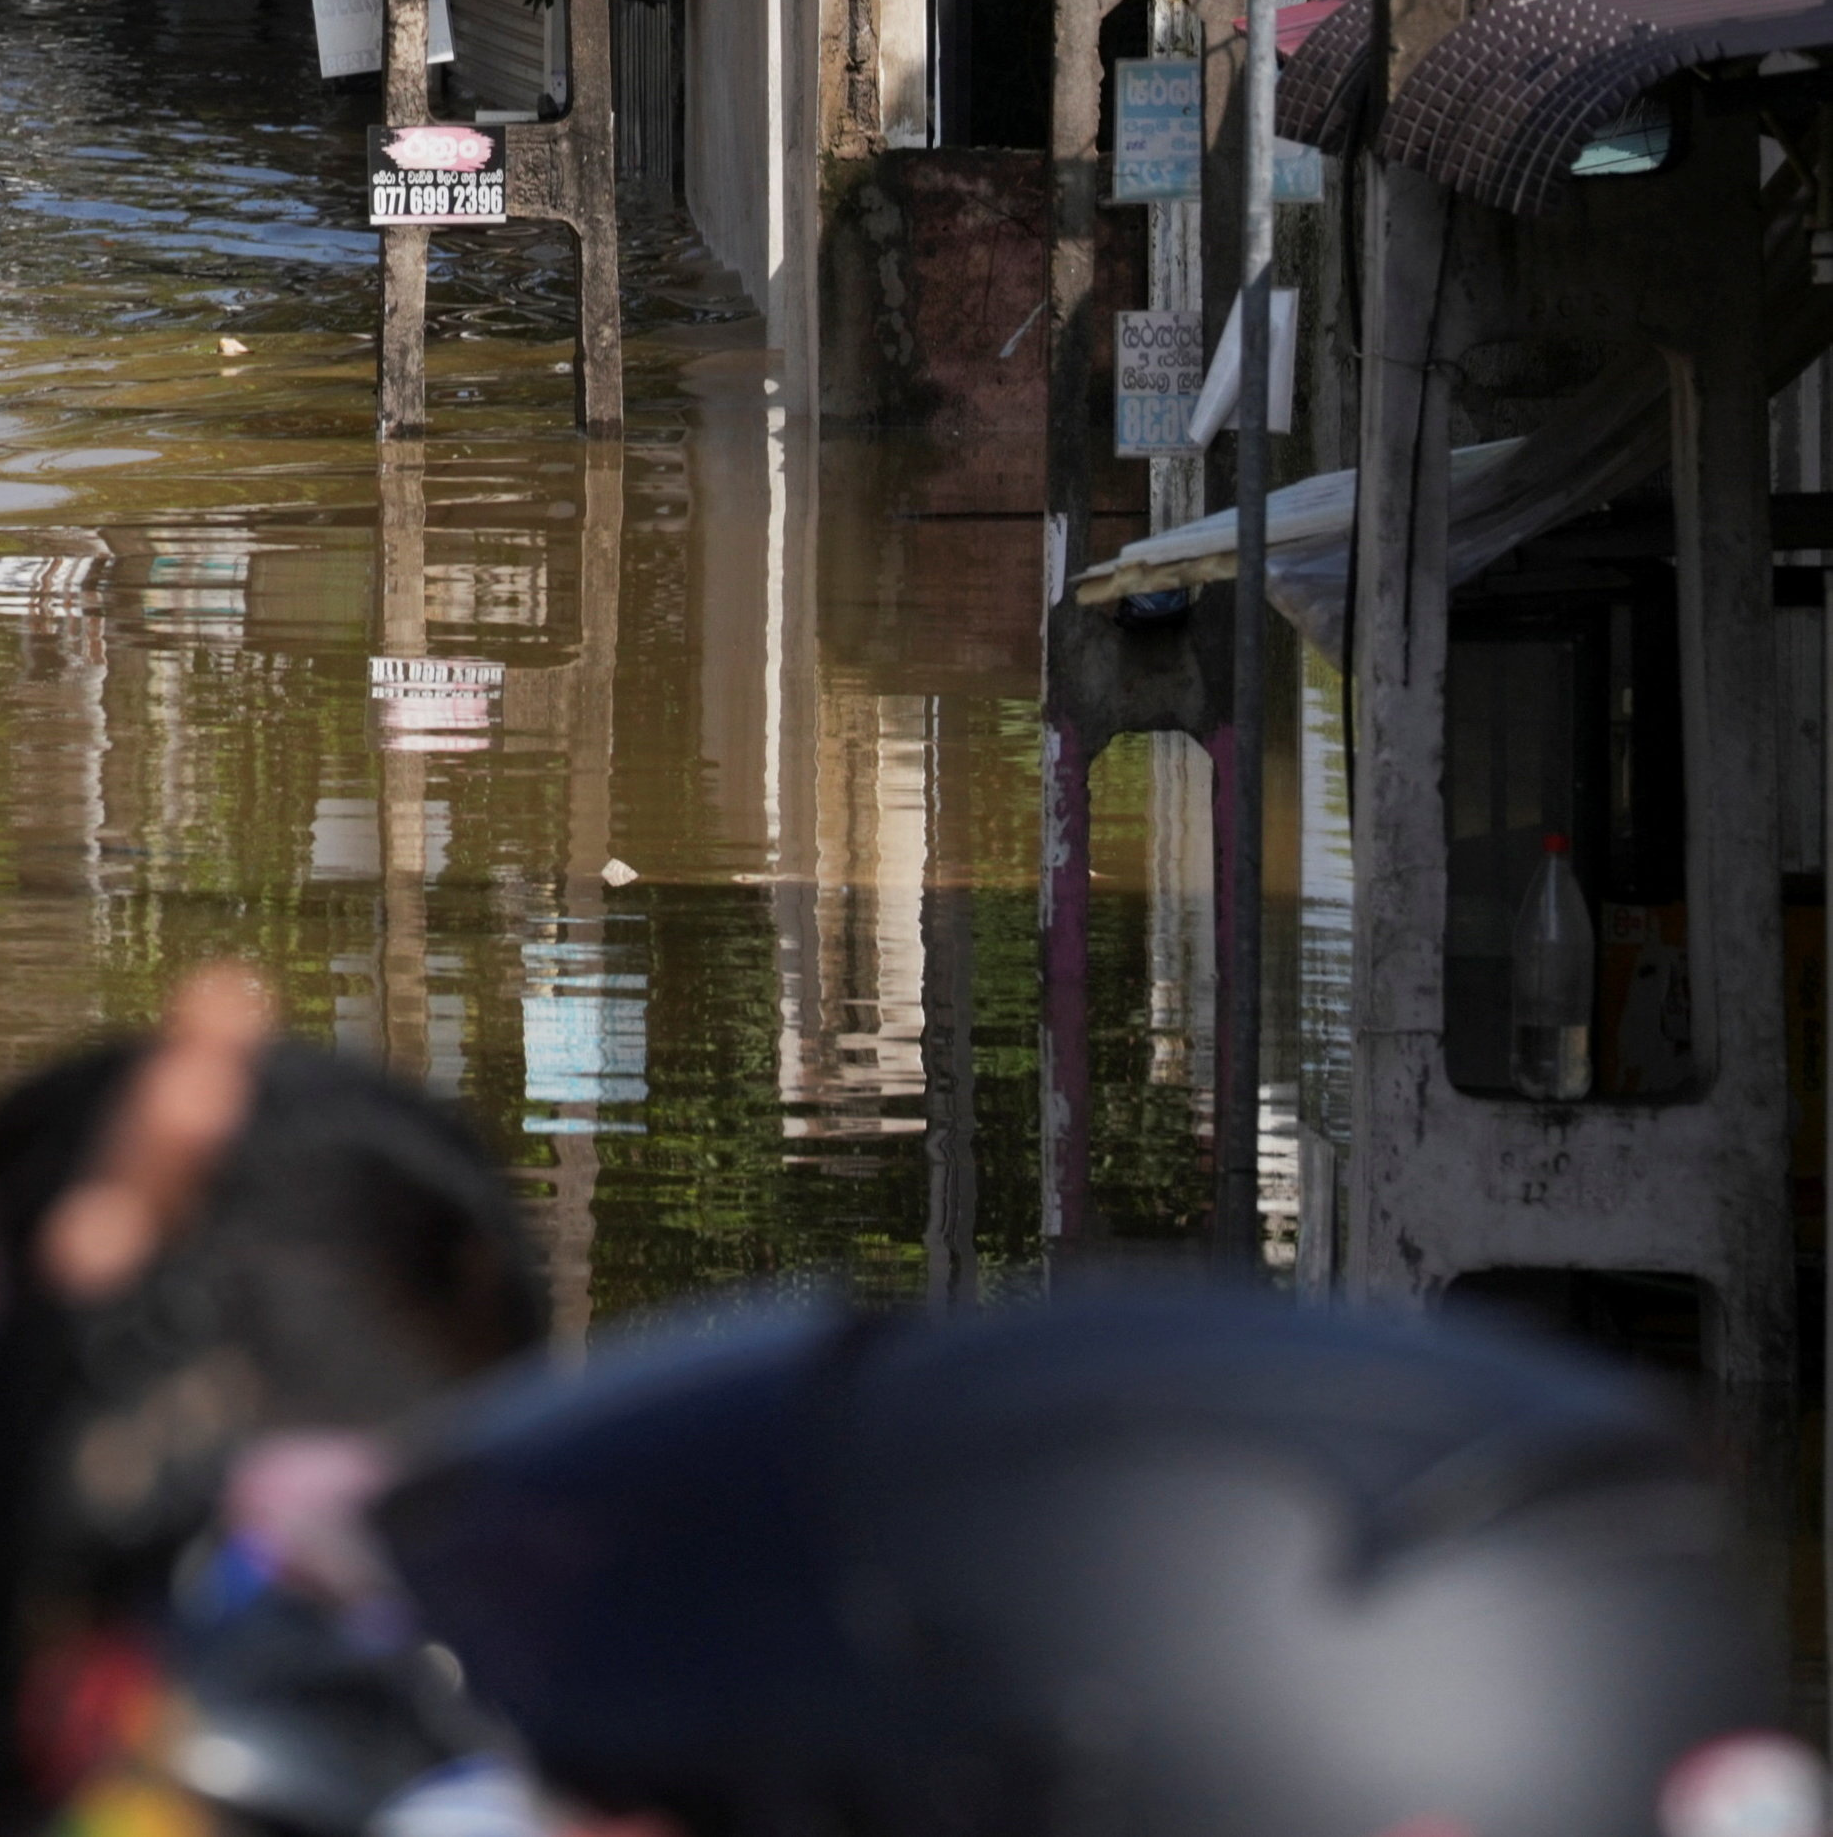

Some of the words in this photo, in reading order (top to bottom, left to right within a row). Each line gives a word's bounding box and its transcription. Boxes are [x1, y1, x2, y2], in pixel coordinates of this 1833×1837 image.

[374, 185, 406, 215] 077
[410, 185, 450, 215] 699
[453, 184, 503, 215] 2396
